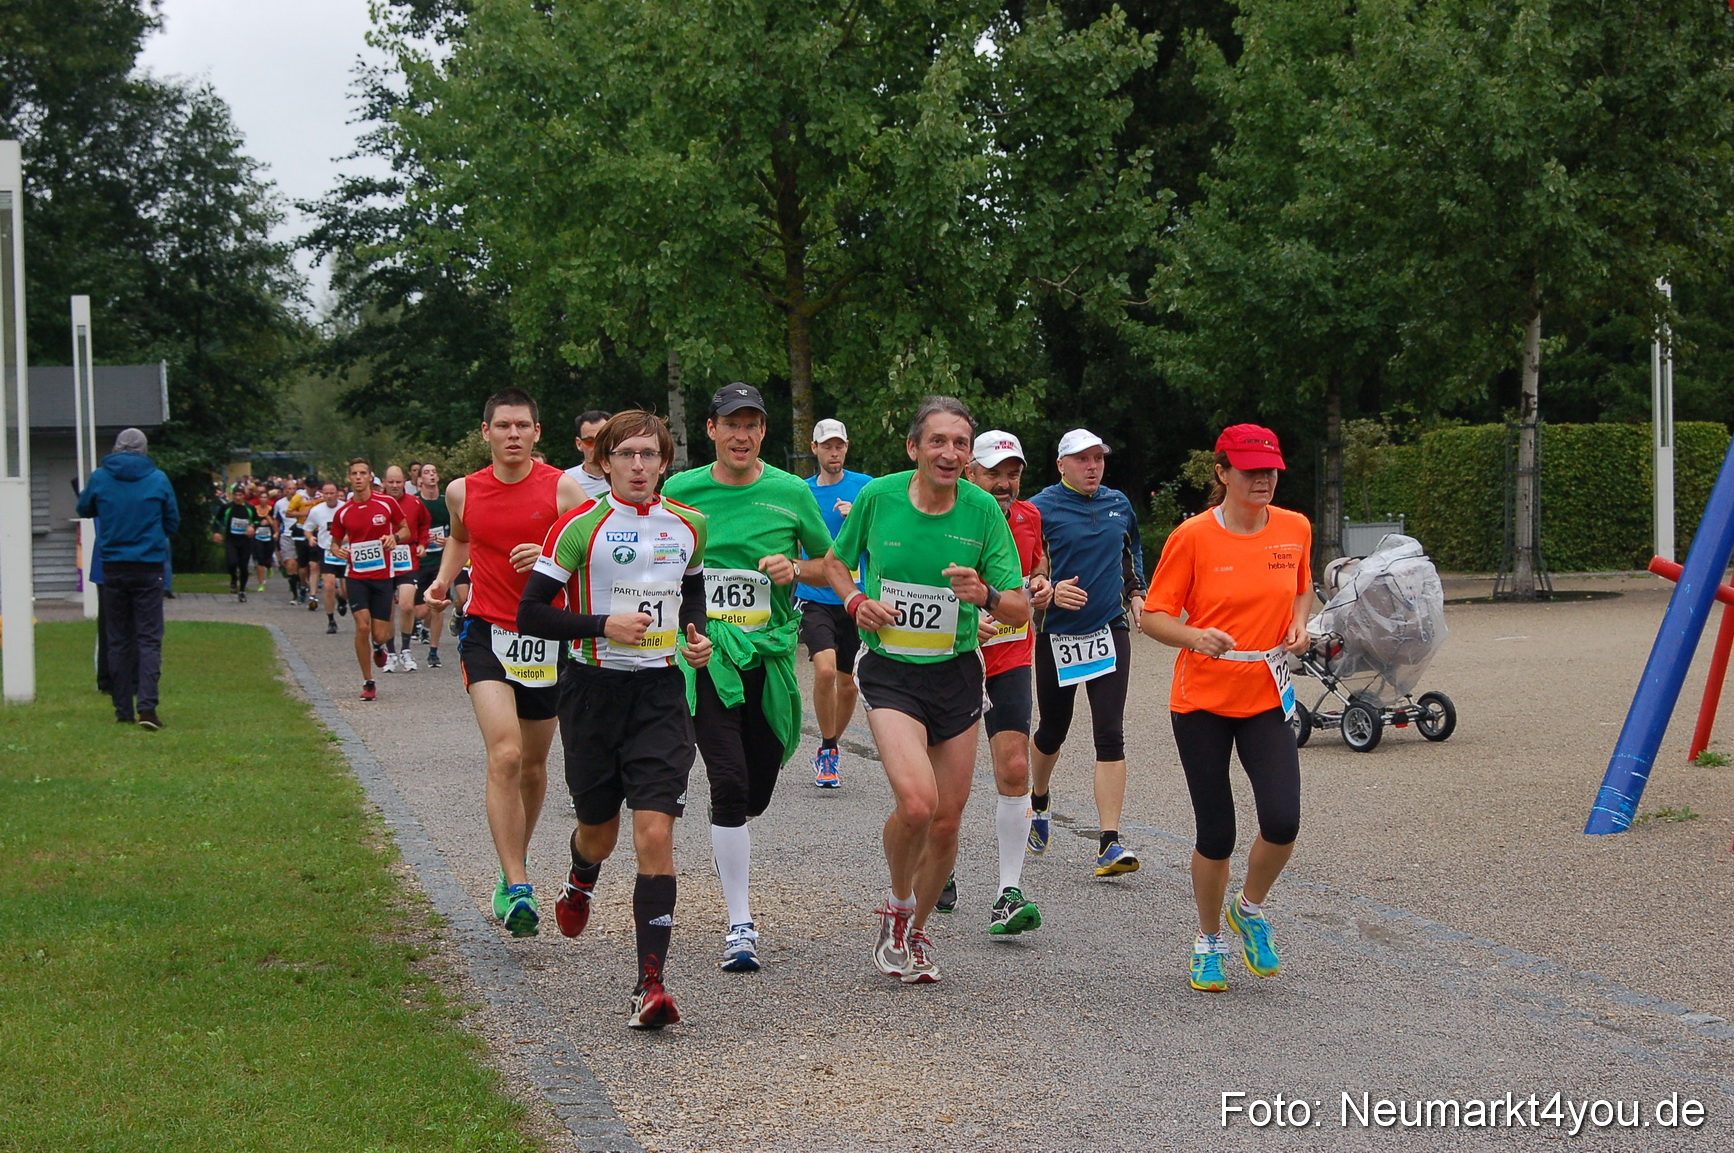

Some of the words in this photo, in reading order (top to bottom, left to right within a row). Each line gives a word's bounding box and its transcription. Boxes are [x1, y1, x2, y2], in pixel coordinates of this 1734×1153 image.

[354, 547, 381, 561] 2555
[1272, 552, 1292, 560] Team
[722, 575, 757, 584] Neumarkt
[613, 586, 641, 597] PARTL
[642, 589, 674, 597] Neumarkt
[711, 583, 755, 608] 463
[882, 585, 905, 598] PARTL
[906, 591, 945, 601] Neumarkt
[721, 613, 746, 624] Peter
[893, 600, 942, 630] 562
[997, 625, 1017, 635] eorg
[1072, 631, 1101, 641] Neumarkt
[640, 635, 663, 647] aniel
[505, 639, 546, 663] 409
[1059, 637, 1109, 665] 3175
